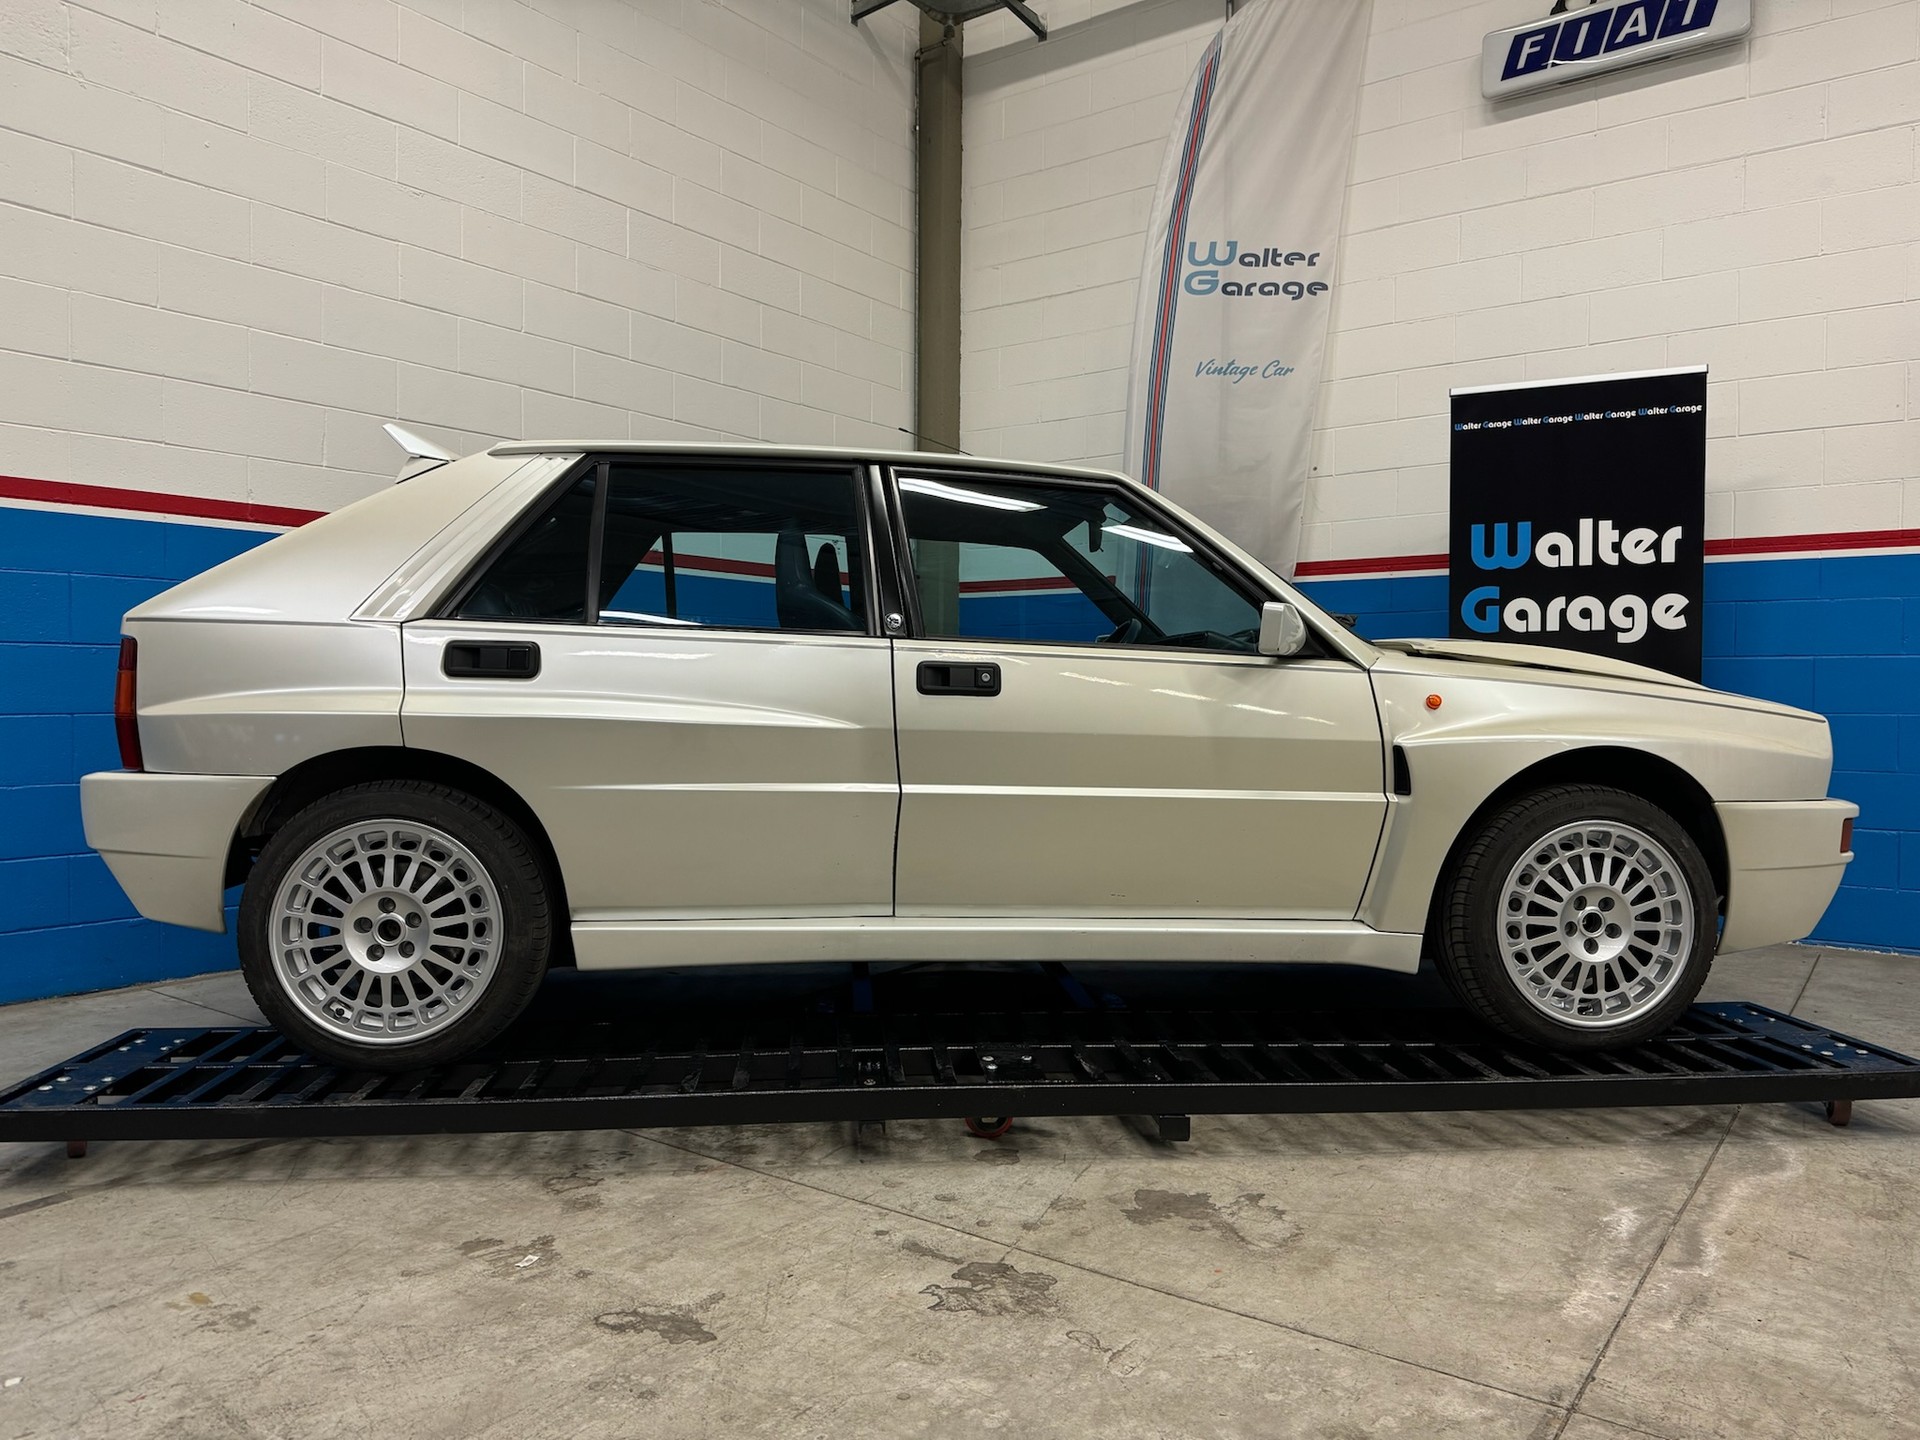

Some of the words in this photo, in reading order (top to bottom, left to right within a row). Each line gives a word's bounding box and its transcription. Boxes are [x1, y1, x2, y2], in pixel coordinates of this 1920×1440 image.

[1187, 240, 1320, 268] Walter
[1184, 270, 1329, 301] Garage
[1195, 359, 1259, 384] Vintage
[1262, 359, 1294, 379] Car
[1454, 420, 1482, 431] Walter
[1482, 418, 1513, 429] Garage
[1513, 415, 1542, 426] Walter
[1542, 413, 1573, 424] Garage
[1574, 410, 1604, 421] Walter
[1604, 408, 1637, 420] Garage
[1638, 405, 1669, 416] Walter
[1669, 403, 1703, 414] Garage
[1470, 518, 1683, 570] Walter
[1460, 586, 1690, 643] Garage
